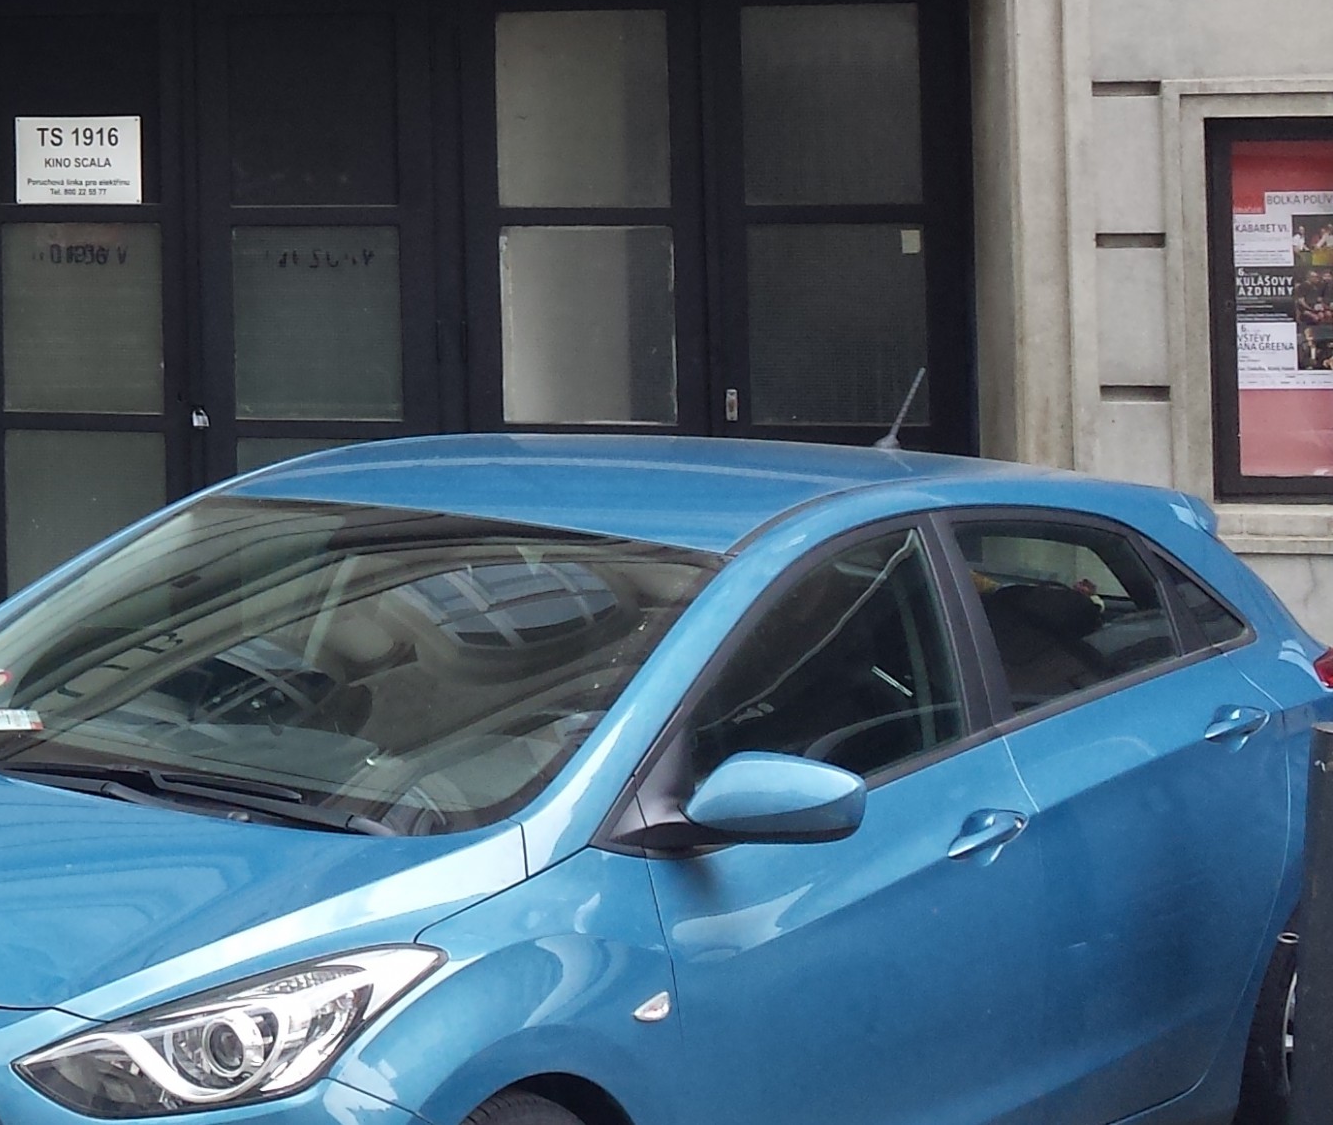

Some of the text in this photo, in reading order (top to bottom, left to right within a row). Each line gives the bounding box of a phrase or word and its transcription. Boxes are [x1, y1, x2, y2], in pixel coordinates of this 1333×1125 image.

[36, 127, 119, 147] TS 1916
[44, 157, 112, 168] KINO SCALA
